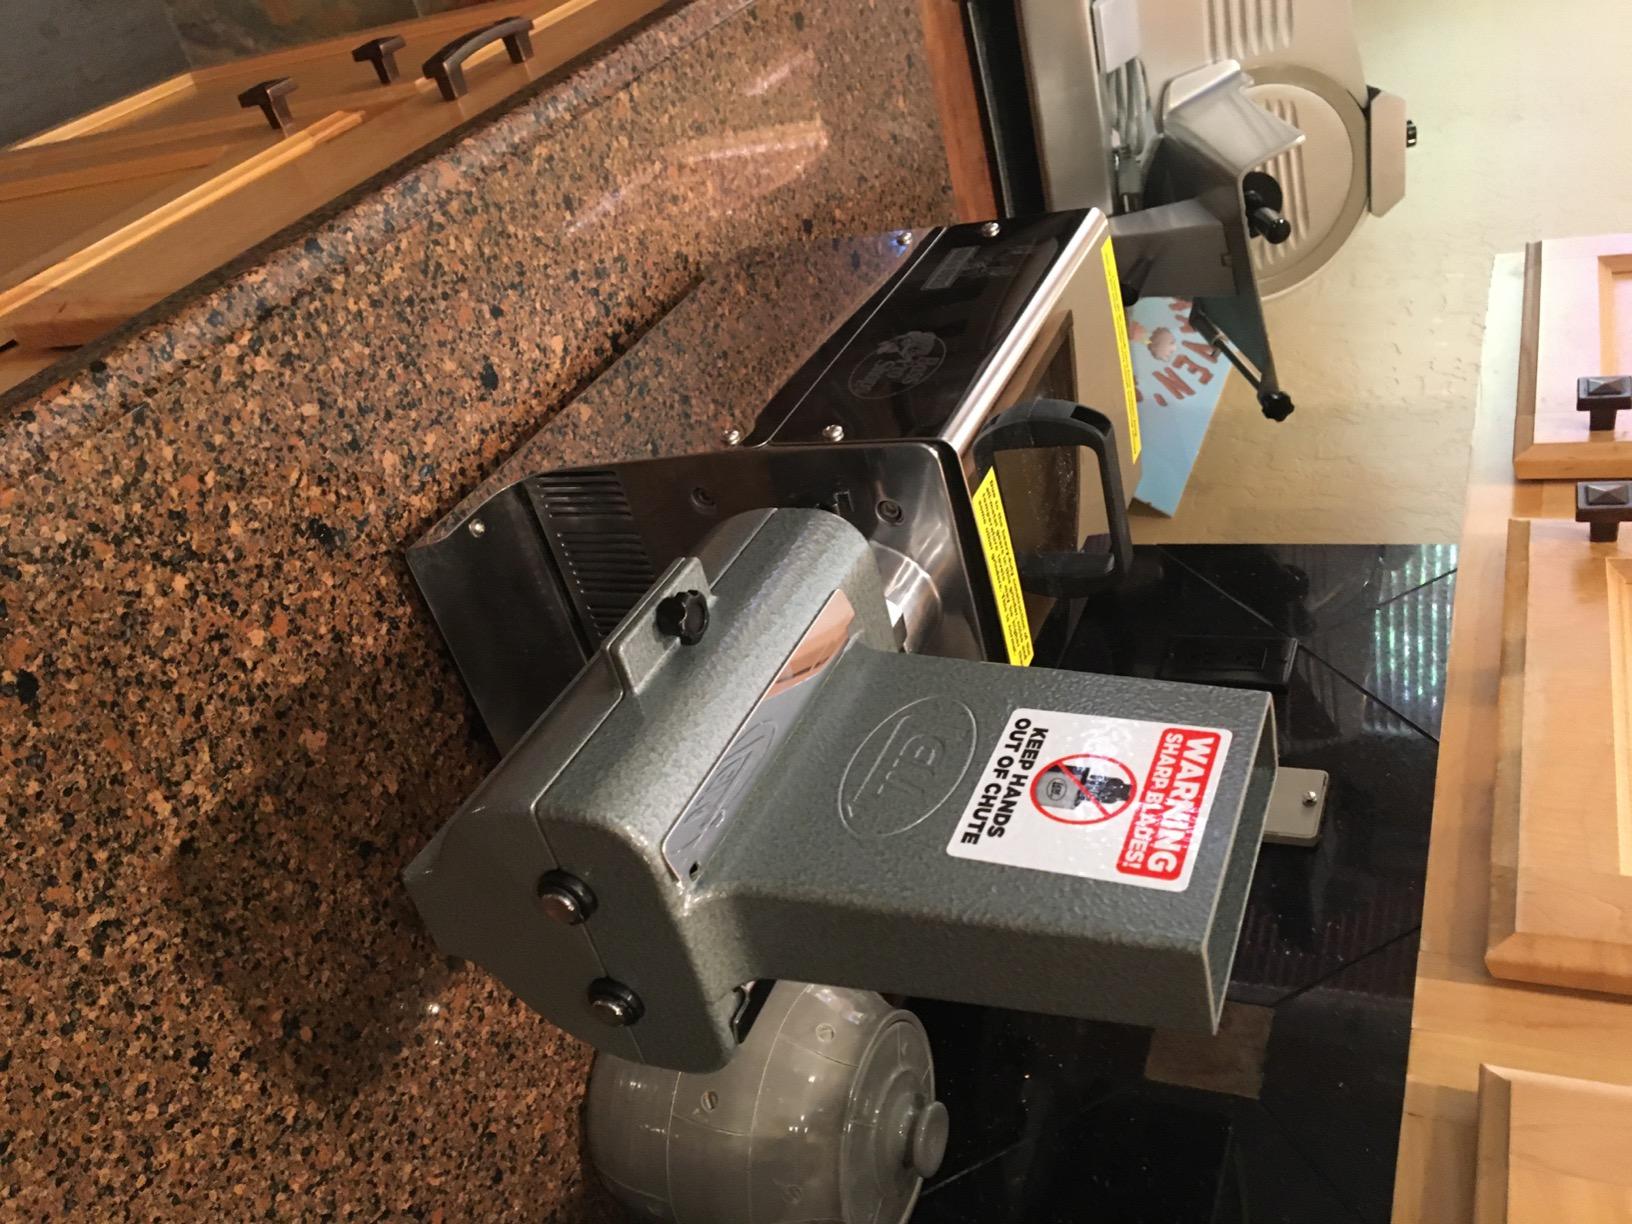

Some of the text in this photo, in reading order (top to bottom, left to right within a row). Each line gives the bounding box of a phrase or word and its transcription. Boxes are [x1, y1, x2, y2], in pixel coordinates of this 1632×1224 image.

[960, 718, 1032, 845] OUT OF CHUTE
[987, 728, 1049, 839] KEEP HANDS
[1125, 732, 1184, 869] SHARP BLADES!
[1146, 737, 1215, 873] WARNING
